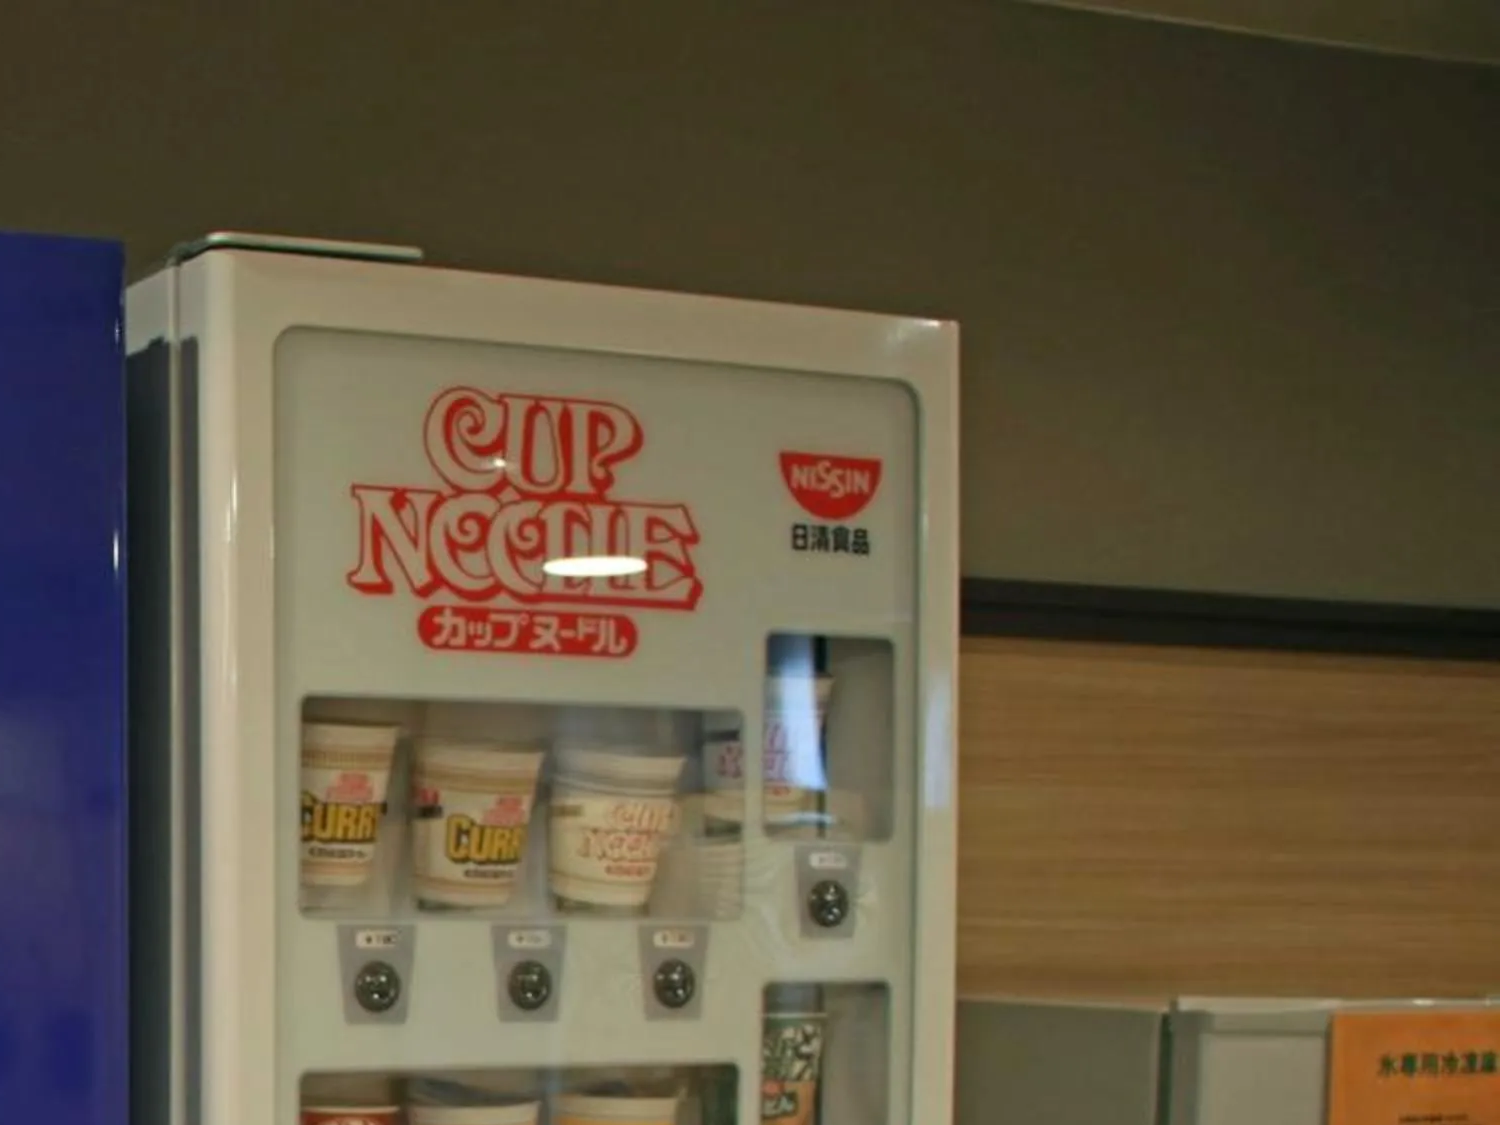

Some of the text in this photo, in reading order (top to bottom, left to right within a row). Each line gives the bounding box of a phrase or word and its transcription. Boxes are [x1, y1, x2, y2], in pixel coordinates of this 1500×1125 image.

[423, 385, 645, 498] CUP
[789, 459, 871, 500] NISSIN
[346, 483, 704, 612] NOODLE
[791, 522, 871, 556] 日清食品
